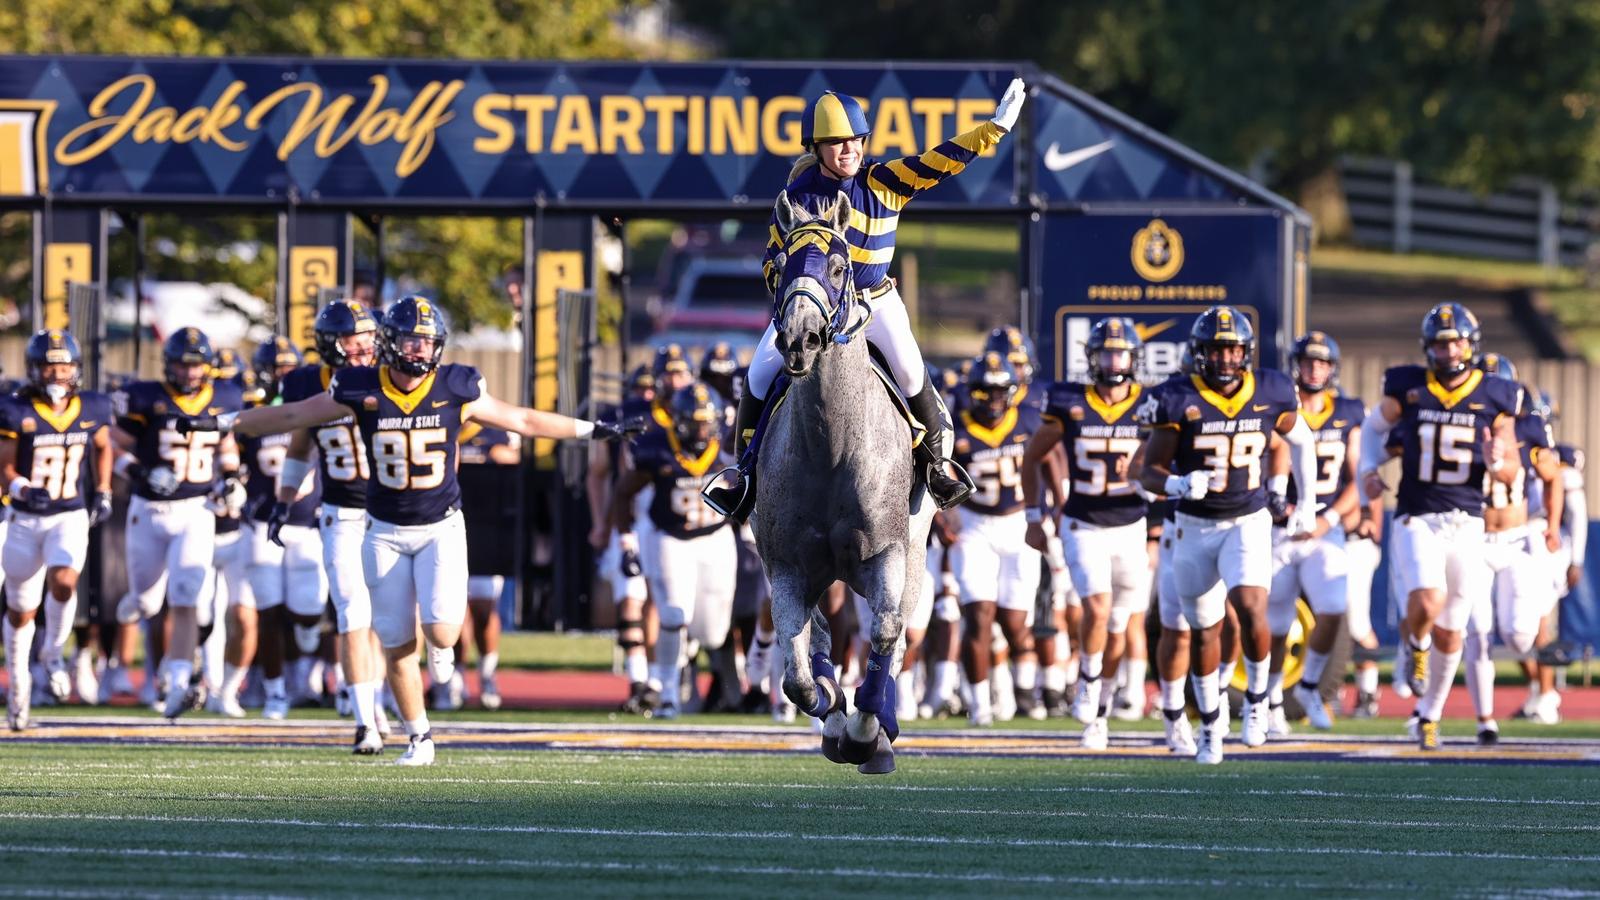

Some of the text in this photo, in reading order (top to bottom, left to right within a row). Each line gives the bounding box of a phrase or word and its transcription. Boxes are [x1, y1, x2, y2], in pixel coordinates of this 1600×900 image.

[55, 74, 465, 178] Jack Wolf
[473, 93, 996, 158] STARTING ATE
[1088, 285, 1227, 300] PROUD PARTNERS
[377, 414, 441, 430] MURRAY STATE
[1201, 418, 1262, 434] MURRAY STATE
[30, 443, 85, 500] 81
[158, 428, 220, 484] 56
[372, 428, 447, 490] 85
[967, 454, 1025, 507] 54
[1193, 430, 1267, 493] 39
[1315, 440, 1346, 495] 3
[1417, 422, 1476, 485] 15
